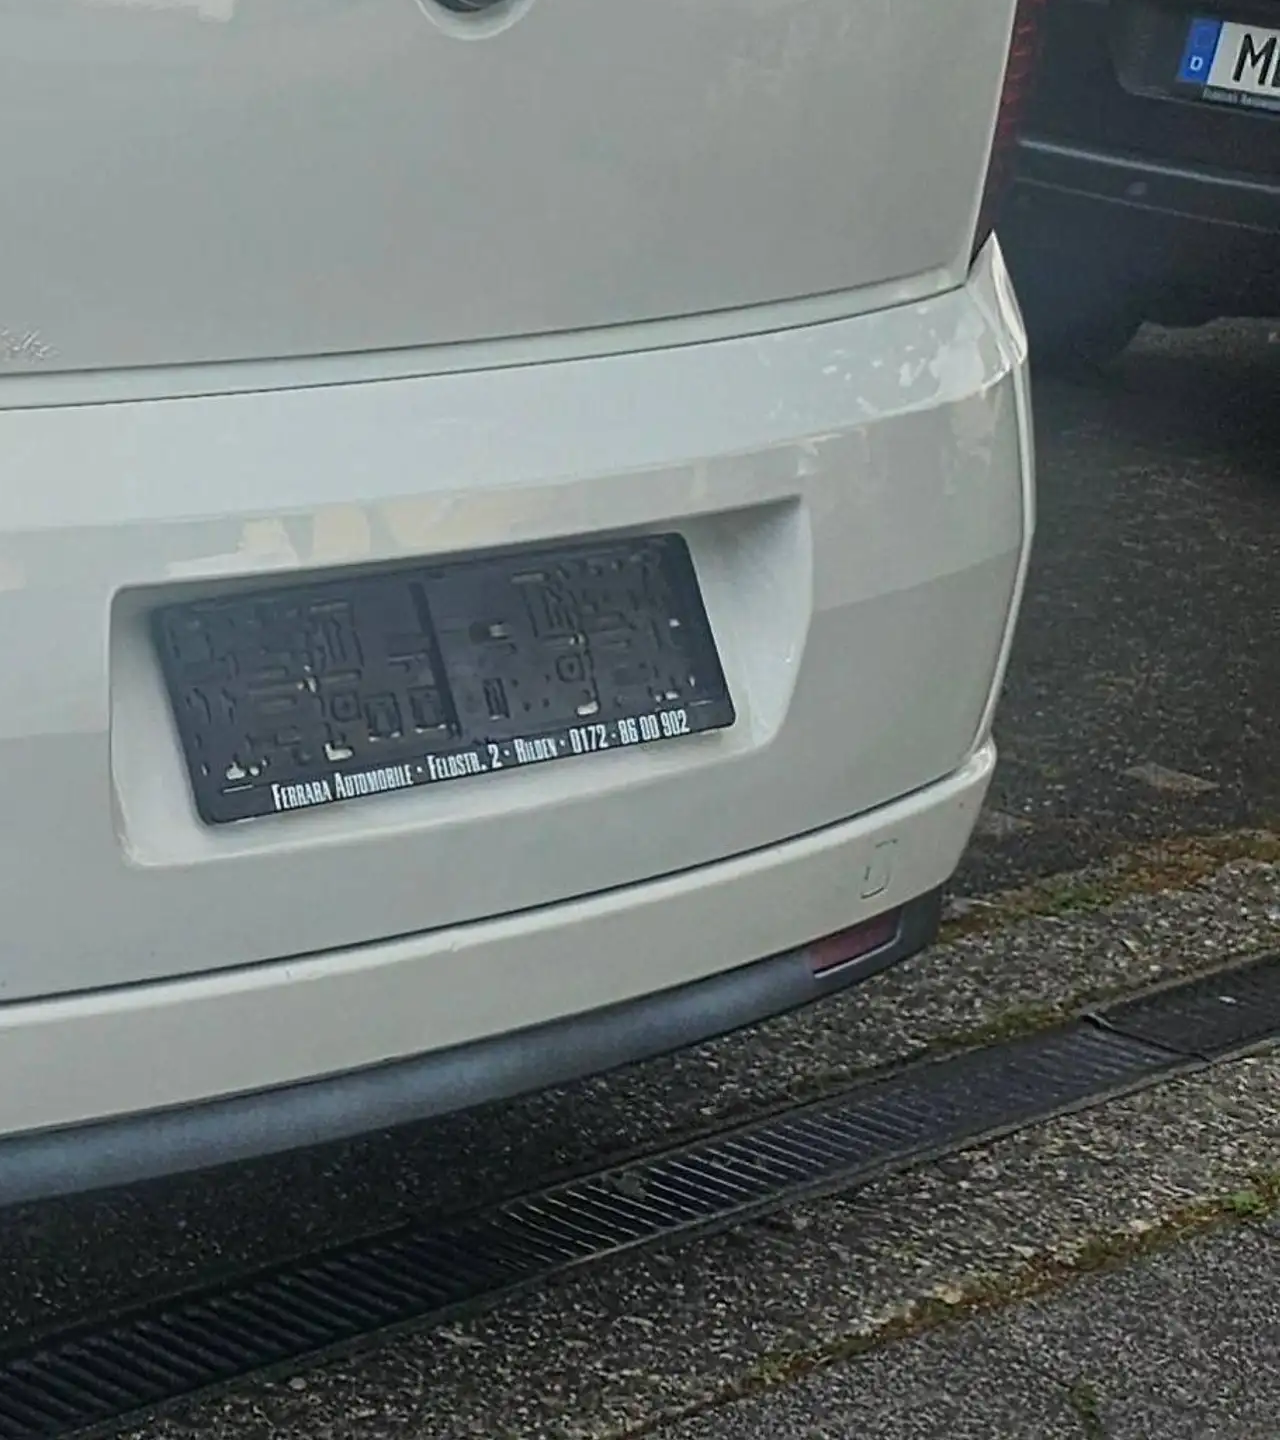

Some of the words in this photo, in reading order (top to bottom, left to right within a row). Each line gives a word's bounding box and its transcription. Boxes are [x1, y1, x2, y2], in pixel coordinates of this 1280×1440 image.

[1190, 56, 1203, 71] D
[1232, 33, 1280, 88] M
[270, 779, 333, 811] FERRARA
[334, 763, 415, 799] AUTOMOBILE
[487, 743, 503, 768] 2
[569, 724, 609, 753] 0172
[618, 718, 639, 744] 86
[640, 714, 660, 740] 00
[660, 709, 691, 736] 902
